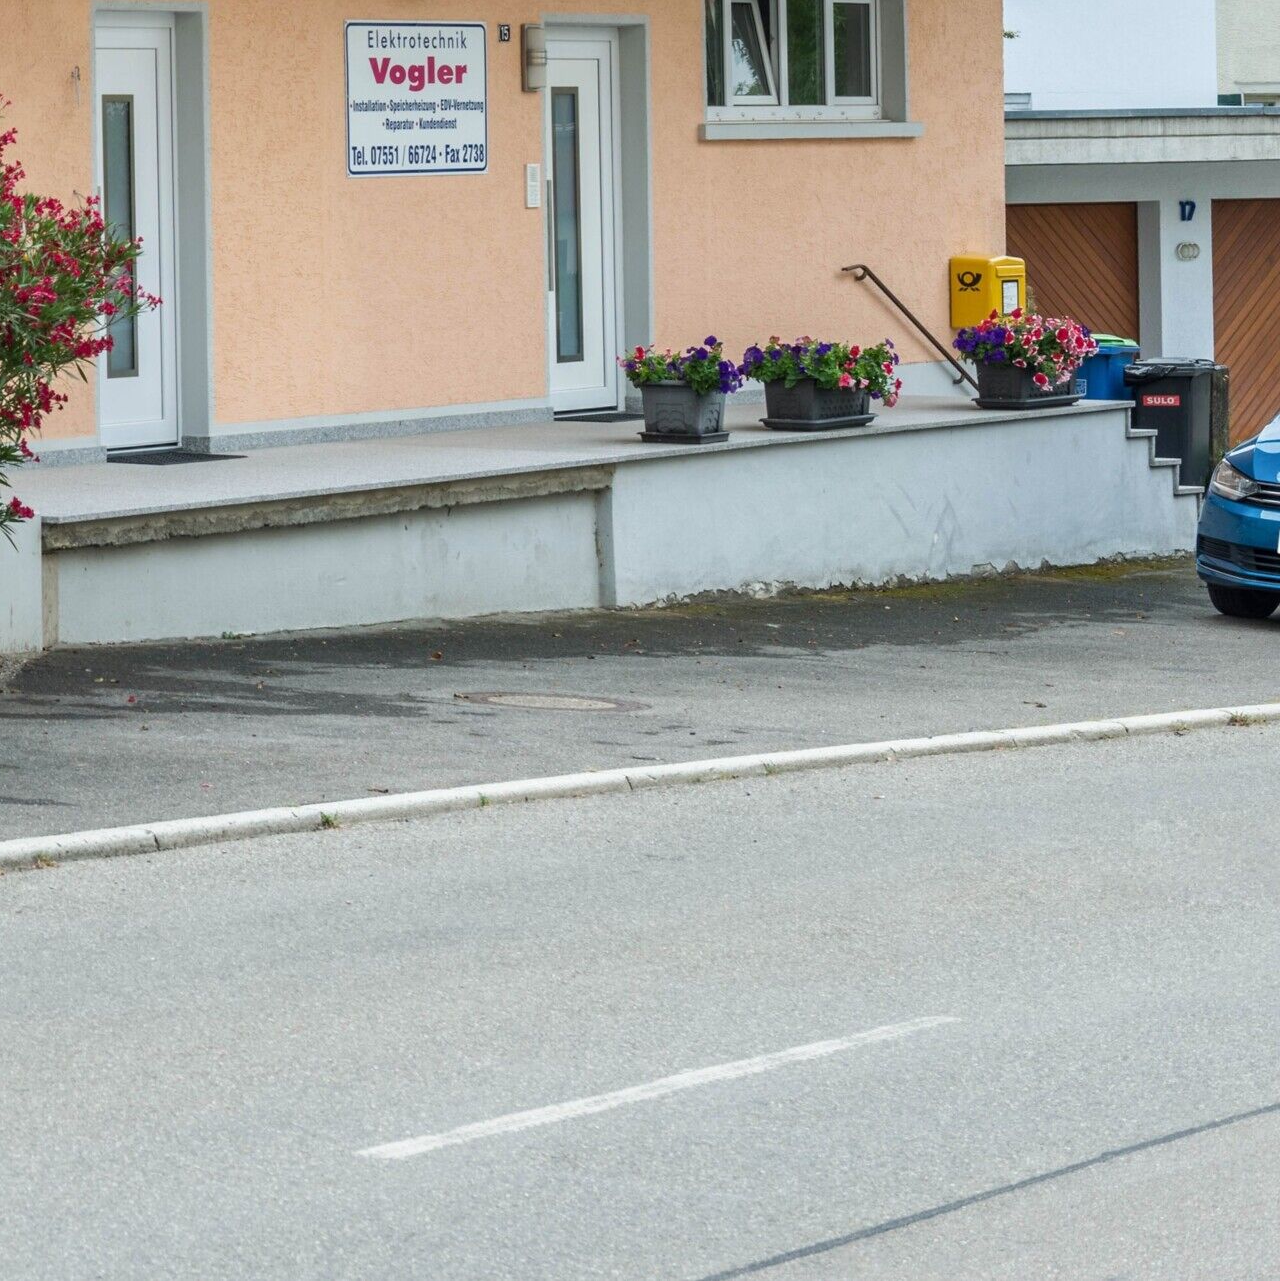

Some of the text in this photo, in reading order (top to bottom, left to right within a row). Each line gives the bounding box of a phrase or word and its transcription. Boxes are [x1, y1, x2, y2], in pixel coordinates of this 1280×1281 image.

[368, 30, 467, 49] Elektrotechnik
[501, 26, 510, 40] 15
[369, 56, 468, 92] Vogler
[353, 99, 484, 114] Installation Speicherheizung EDV-Vernetzung
[386, 118, 457, 132] Reparatur Kundendienst
[351, 146, 368, 166] Tel.
[371, 146, 399, 165] 07551
[408, 145, 436, 164] 66724
[445, 145, 460, 163] Fax
[463, 144, 484, 163] 2738
[1179, 201, 1196, 221] 17
[1146, 397, 1175, 405] SULO
